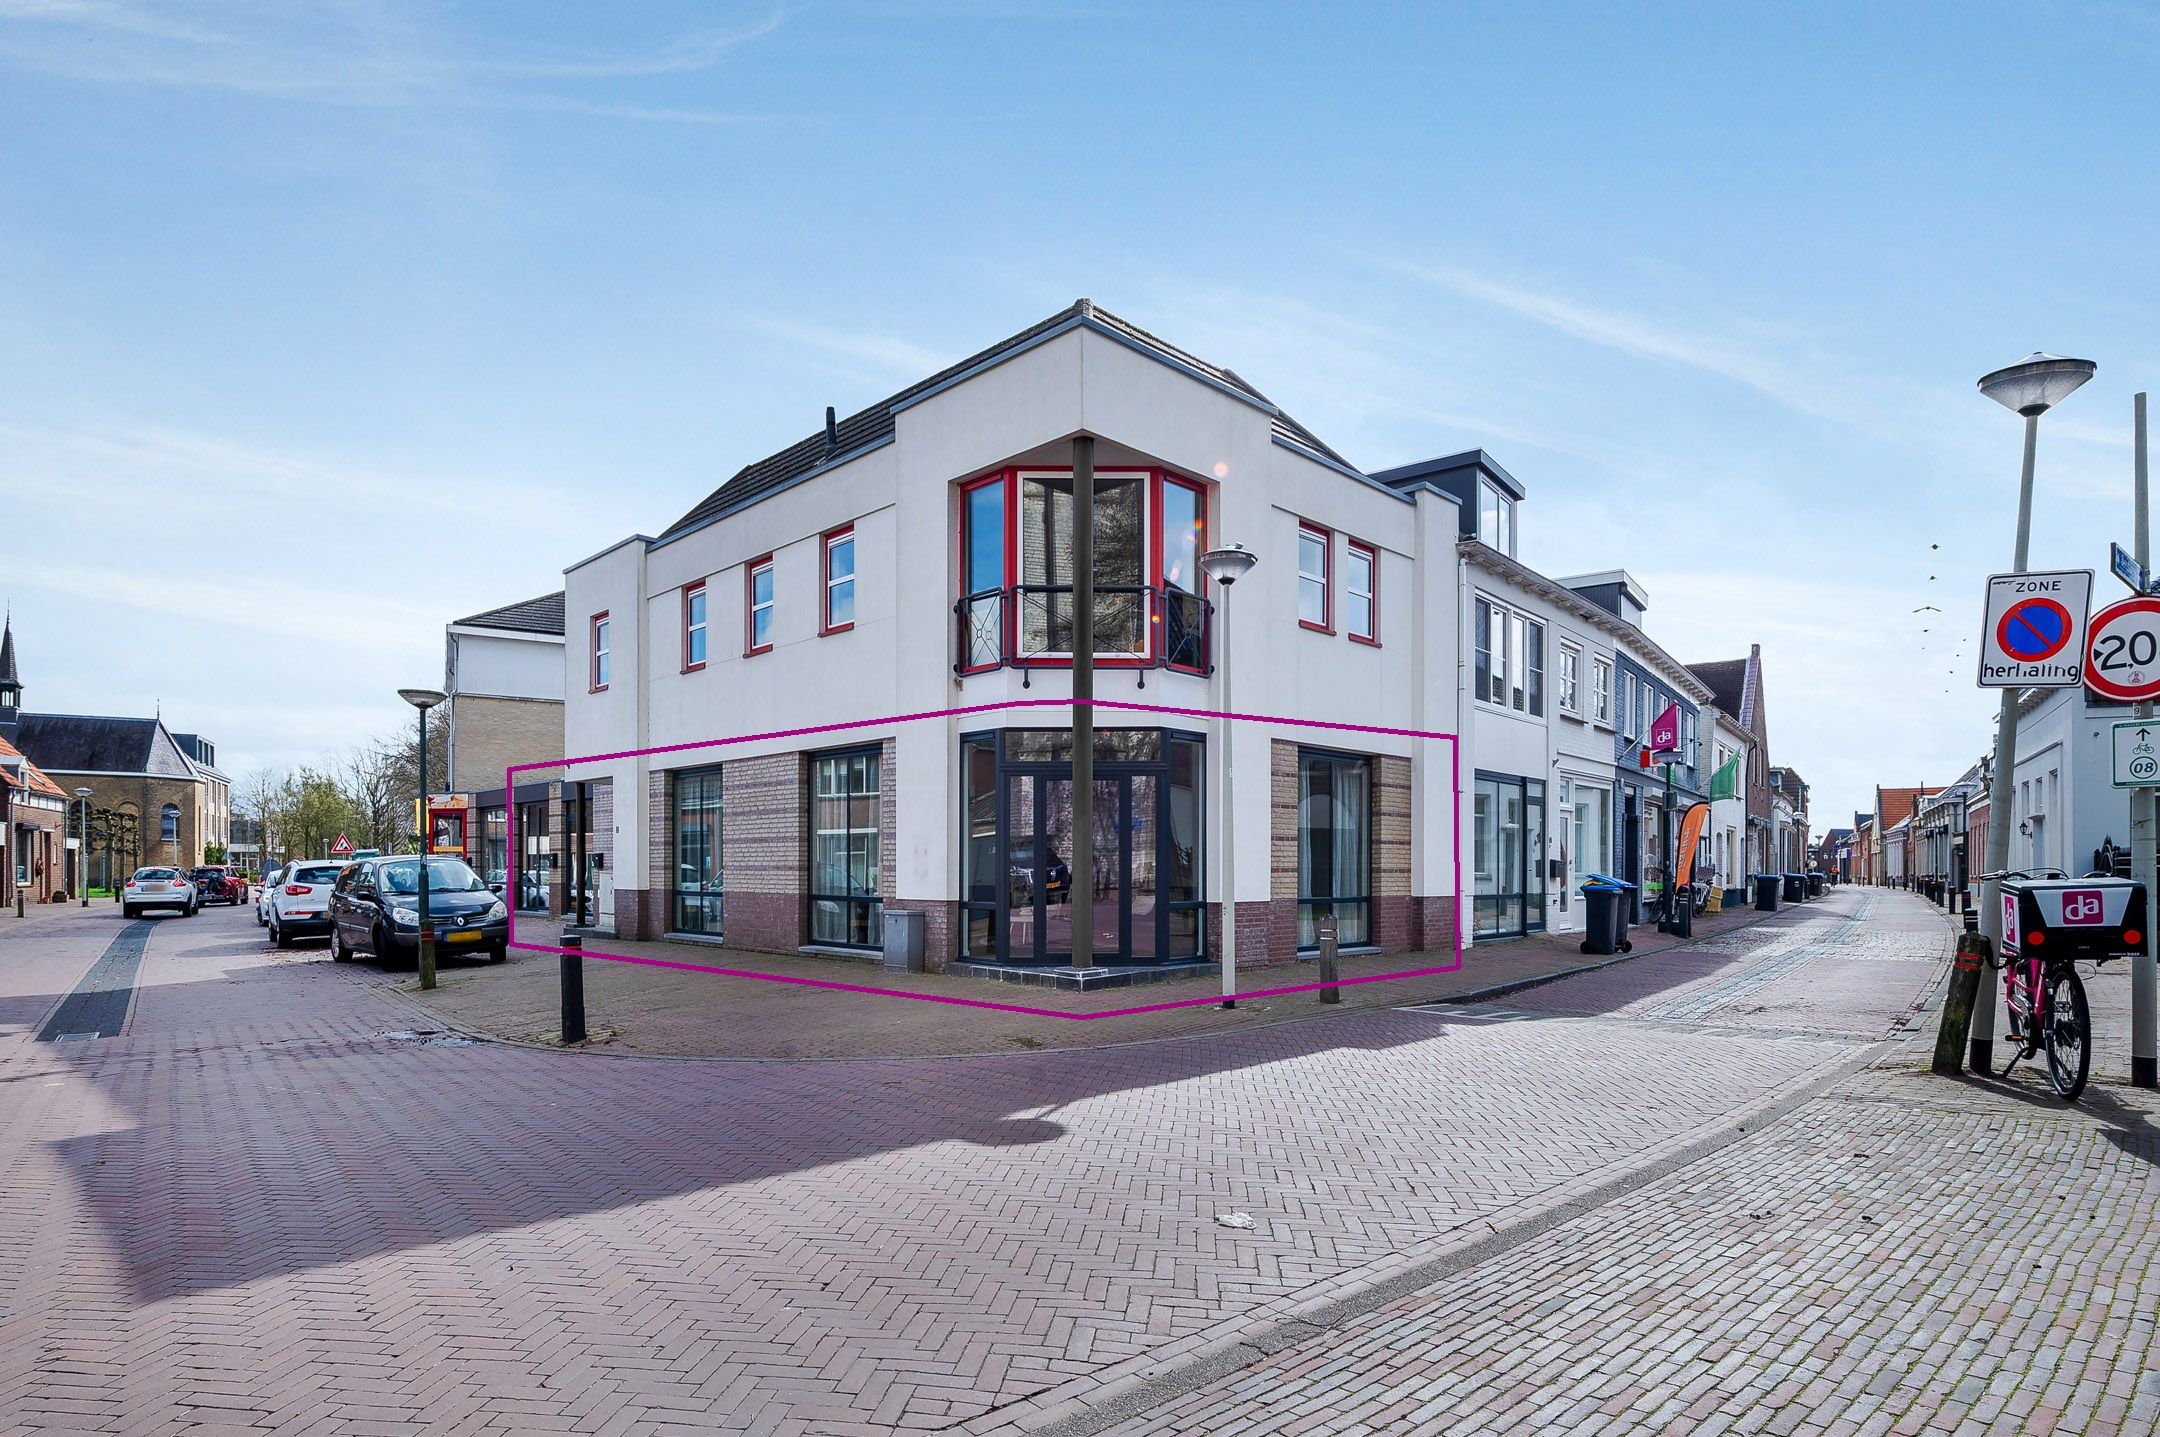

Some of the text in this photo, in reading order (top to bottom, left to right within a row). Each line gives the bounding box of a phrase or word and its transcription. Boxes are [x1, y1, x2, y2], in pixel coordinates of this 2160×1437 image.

[2016, 580, 2062, 593] ZONE
[1657, 730, 1671, 743] da
[2134, 762, 2154, 774] 08
[2065, 895, 2099, 920] da
[2005, 902, 2014, 935] da
